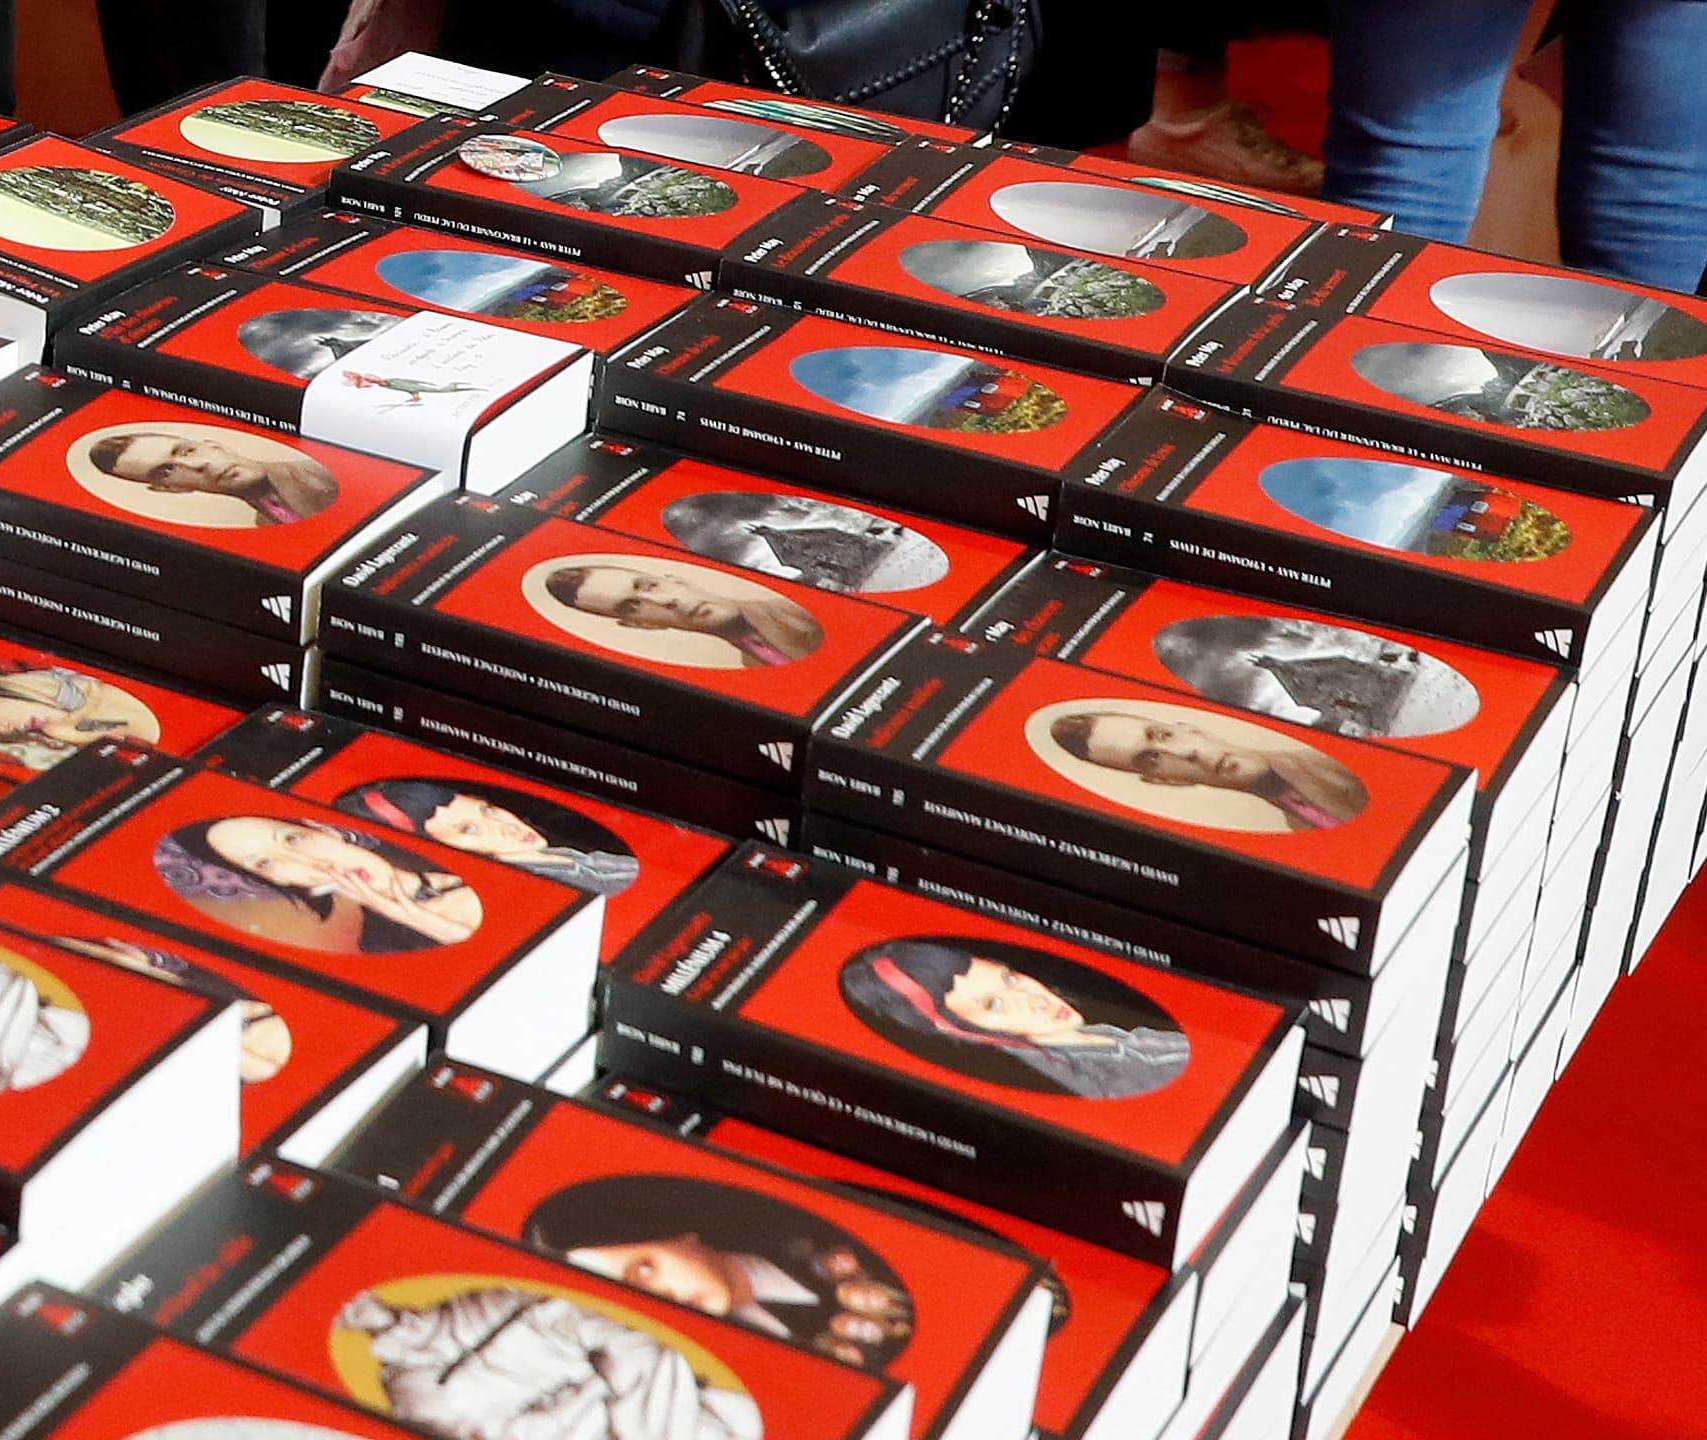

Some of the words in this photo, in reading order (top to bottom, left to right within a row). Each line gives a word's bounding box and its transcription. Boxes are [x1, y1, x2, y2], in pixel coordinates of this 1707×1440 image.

[350, 157, 375, 171] Peter
[365, 151, 392, 163] May
[340, 196, 362, 208] NOIR
[363, 200, 386, 213] BABEL
[413, 212, 440, 225] PERDU
[440, 218, 456, 229] LAC
[456, 222, 470, 232] DU
[470, 224, 522, 244] BRACONNIER
[522, 236, 532, 246] LE
[539, 241, 557, 251] MAY
[223, 251, 250, 264] Peter
[241, 245, 268, 255] May
[558, 244, 581, 257] PETER
[78, 319, 107, 336] Peter
[97, 310, 127, 323] May
[66, 364, 88, 378] NOIR
[89, 370, 114, 385] BABEL
[614, 394, 640, 409] NOIR
[640, 401, 667, 416] BABEL
[699, 417, 727, 432] LEWIS
[728, 423, 741, 435] DE
[742, 427, 784, 446] L'HOMME
[793, 441, 813, 454] MAY
[814, 446, 842, 461] PETER
[1073, 514, 1100, 530] NOIR
[1101, 521, 1132, 537] BABEL
[15, 526, 63, 548] INDÉCENCE
[70, 542, 131, 568] LAGERCRANTZ
[1169, 539, 1200, 555] LEWIS
[1201, 547, 1216, 559] DE
[130, 559, 160, 576] DAVID
[342, 561, 381, 588] David
[365, 532, 420, 568] Lagercrantz
[1217, 551, 1266, 572] L'HOMME
[1277, 566, 1300, 580] MAY
[1300, 572, 1332, 589] PETER
[16, 590, 64, 613] INDÉCENCE
[71, 607, 131, 633] LAGERCRANTZ
[330, 615, 355, 631] NOIR
[131, 625, 160, 642] DAVID
[357, 623, 385, 641] BABEL
[421, 642, 472, 666] MANIFESTE
[473, 657, 528, 683] INDÉCENCE
[536, 677, 607, 707] LAGERCRANTZ
[607, 698, 641, 717] DAVID
